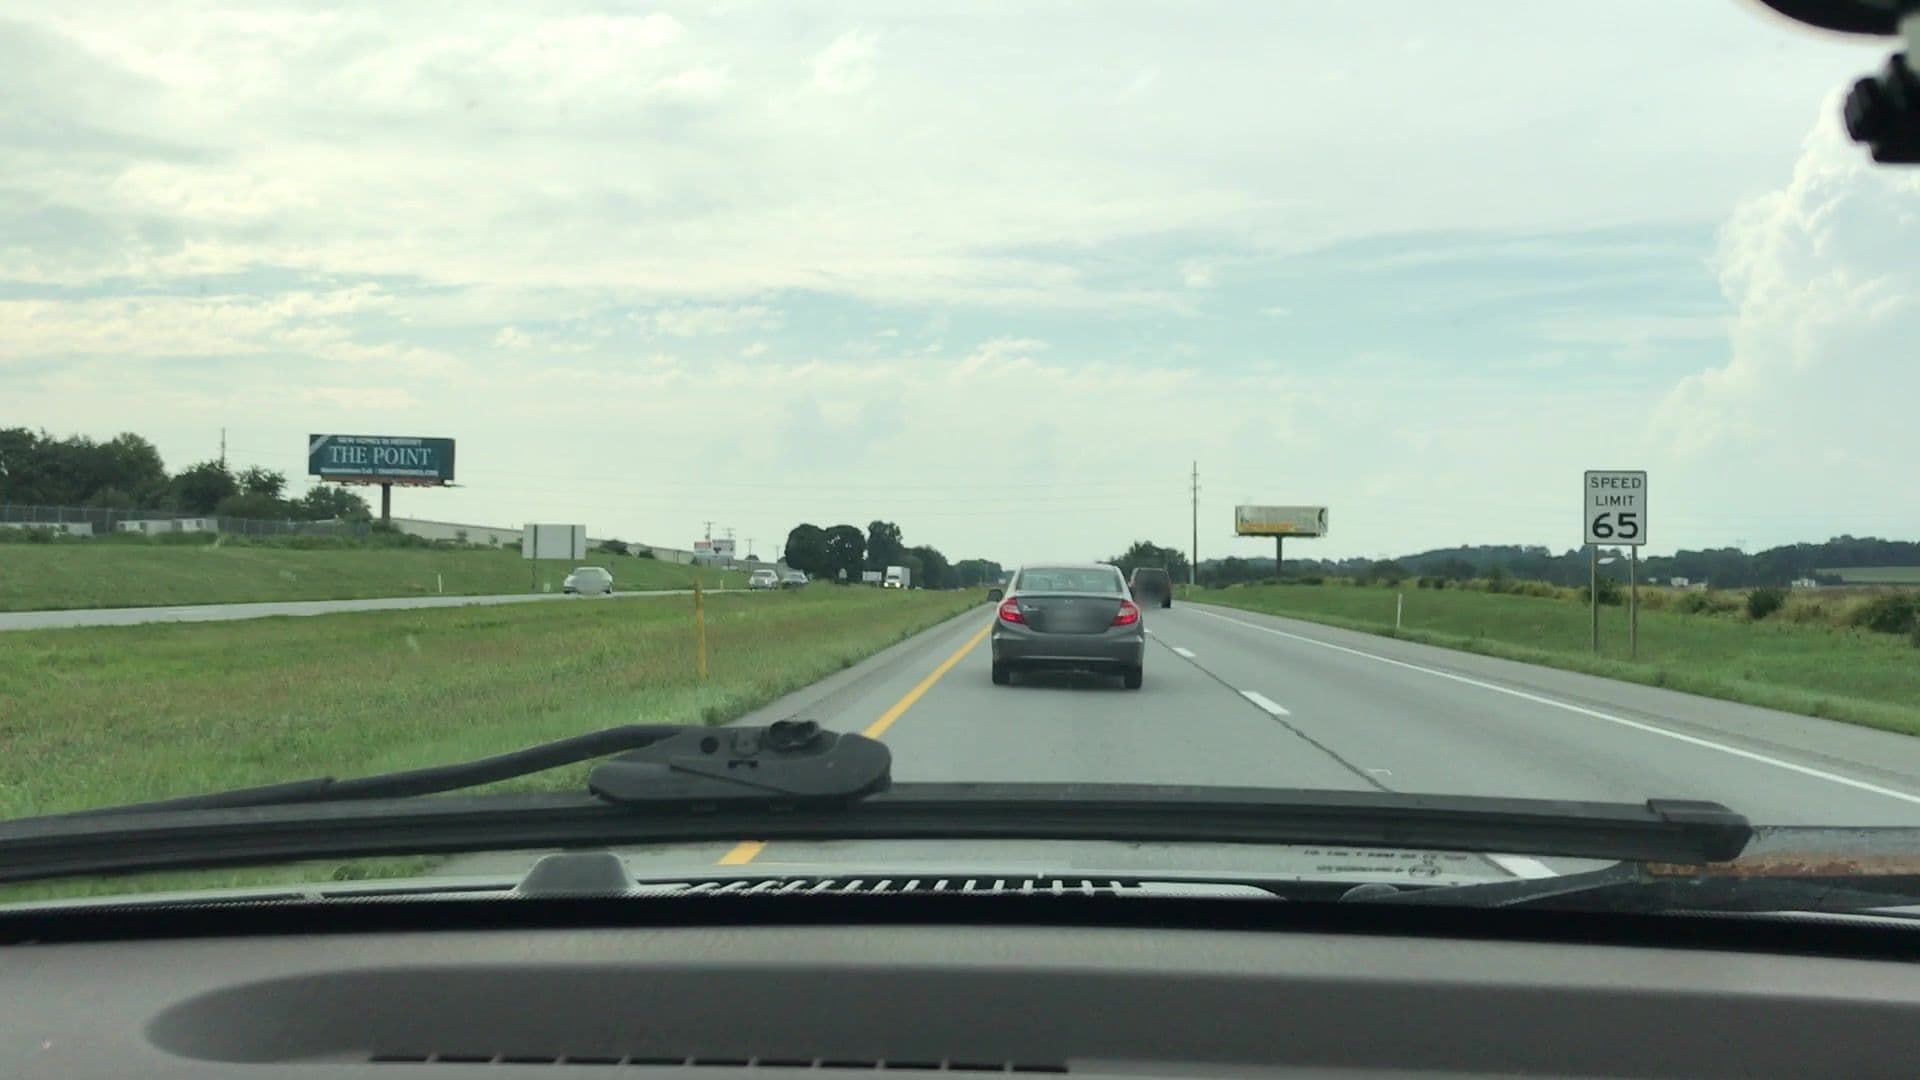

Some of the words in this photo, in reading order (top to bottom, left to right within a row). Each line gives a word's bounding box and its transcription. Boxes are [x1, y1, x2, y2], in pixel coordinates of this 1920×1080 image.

[330, 446, 367, 464] THE
[373, 447, 431, 466] POINT
[1591, 476, 1642, 489] SPEED
[1595, 495, 1635, 506] LIMIT
[1592, 512, 1638, 539] 65
